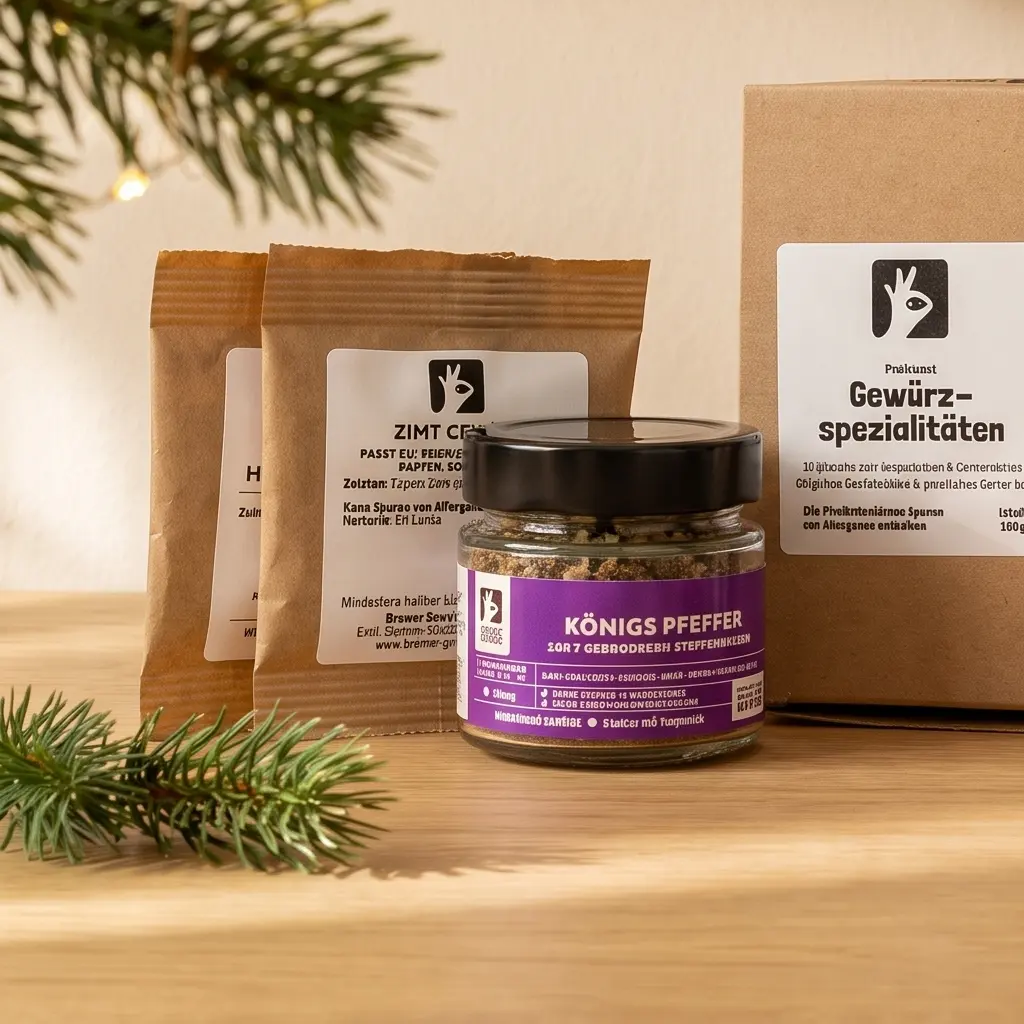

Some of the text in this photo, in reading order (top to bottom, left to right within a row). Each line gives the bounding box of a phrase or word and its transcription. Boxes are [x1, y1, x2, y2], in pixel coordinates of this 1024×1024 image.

[850, 379, 973, 408] Gewürz-
[394, 424, 441, 440] ZIMT
[819, 413, 1005, 448] spezialitäten
[360, 449, 396, 459] PASST
[803, 462, 814, 472] 10
[947, 462, 953, 472] &
[913, 479, 920, 489] &
[343, 502, 371, 513] Kana
[413, 504, 432, 513] von
[565, 610, 742, 636] KÖNIGS PFEFFER
[573, 643, 581, 653] 7
